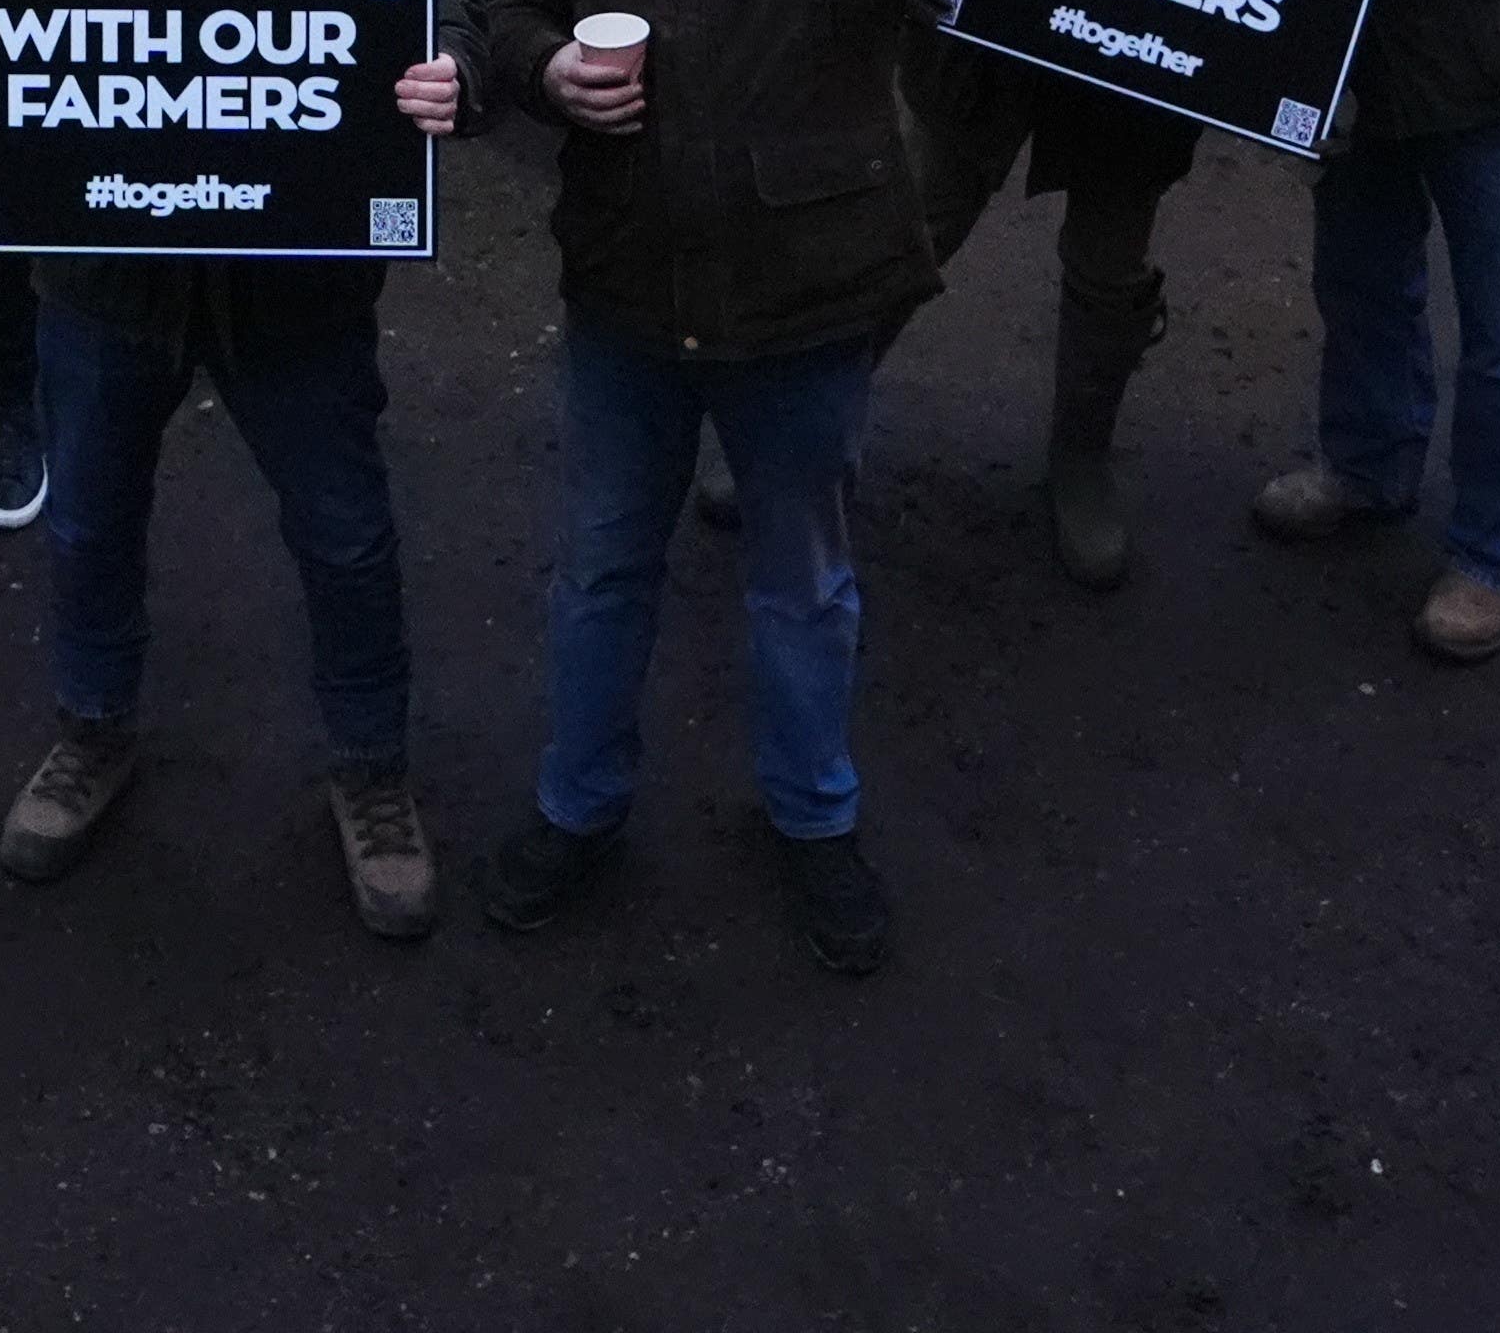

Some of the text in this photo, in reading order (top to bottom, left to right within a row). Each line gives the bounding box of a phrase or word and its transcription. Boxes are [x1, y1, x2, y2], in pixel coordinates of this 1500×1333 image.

[199, 10, 356, 64] OUR
[1050, 6, 1203, 76] #together
[8, 74, 341, 130] FARMERS
[85, 174, 271, 216] #together
